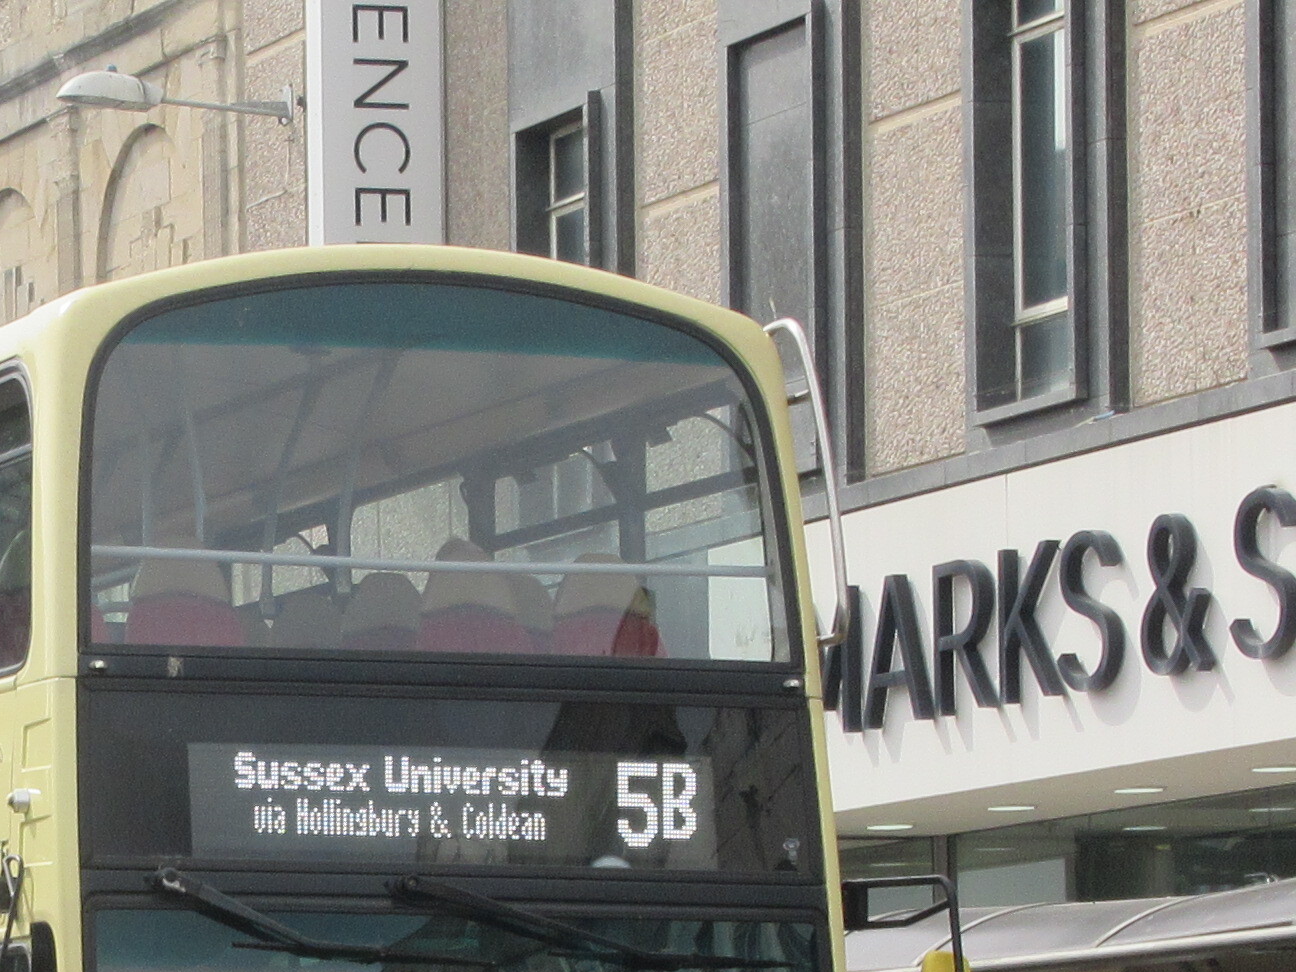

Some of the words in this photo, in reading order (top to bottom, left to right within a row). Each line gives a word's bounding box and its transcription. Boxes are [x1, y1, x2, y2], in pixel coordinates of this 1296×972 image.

[352, 4, 412, 244] ENCE
[1141, 513, 1217, 677] &
[234, 751, 371, 792] Sussex
[384, 756, 570, 798] University
[615, 761, 698, 848] 5B
[253, 797, 286, 835] via
[295, 797, 421, 838] Hollingbury
[429, 801, 453, 839] &
[461, 802, 547, 842] Coldean
